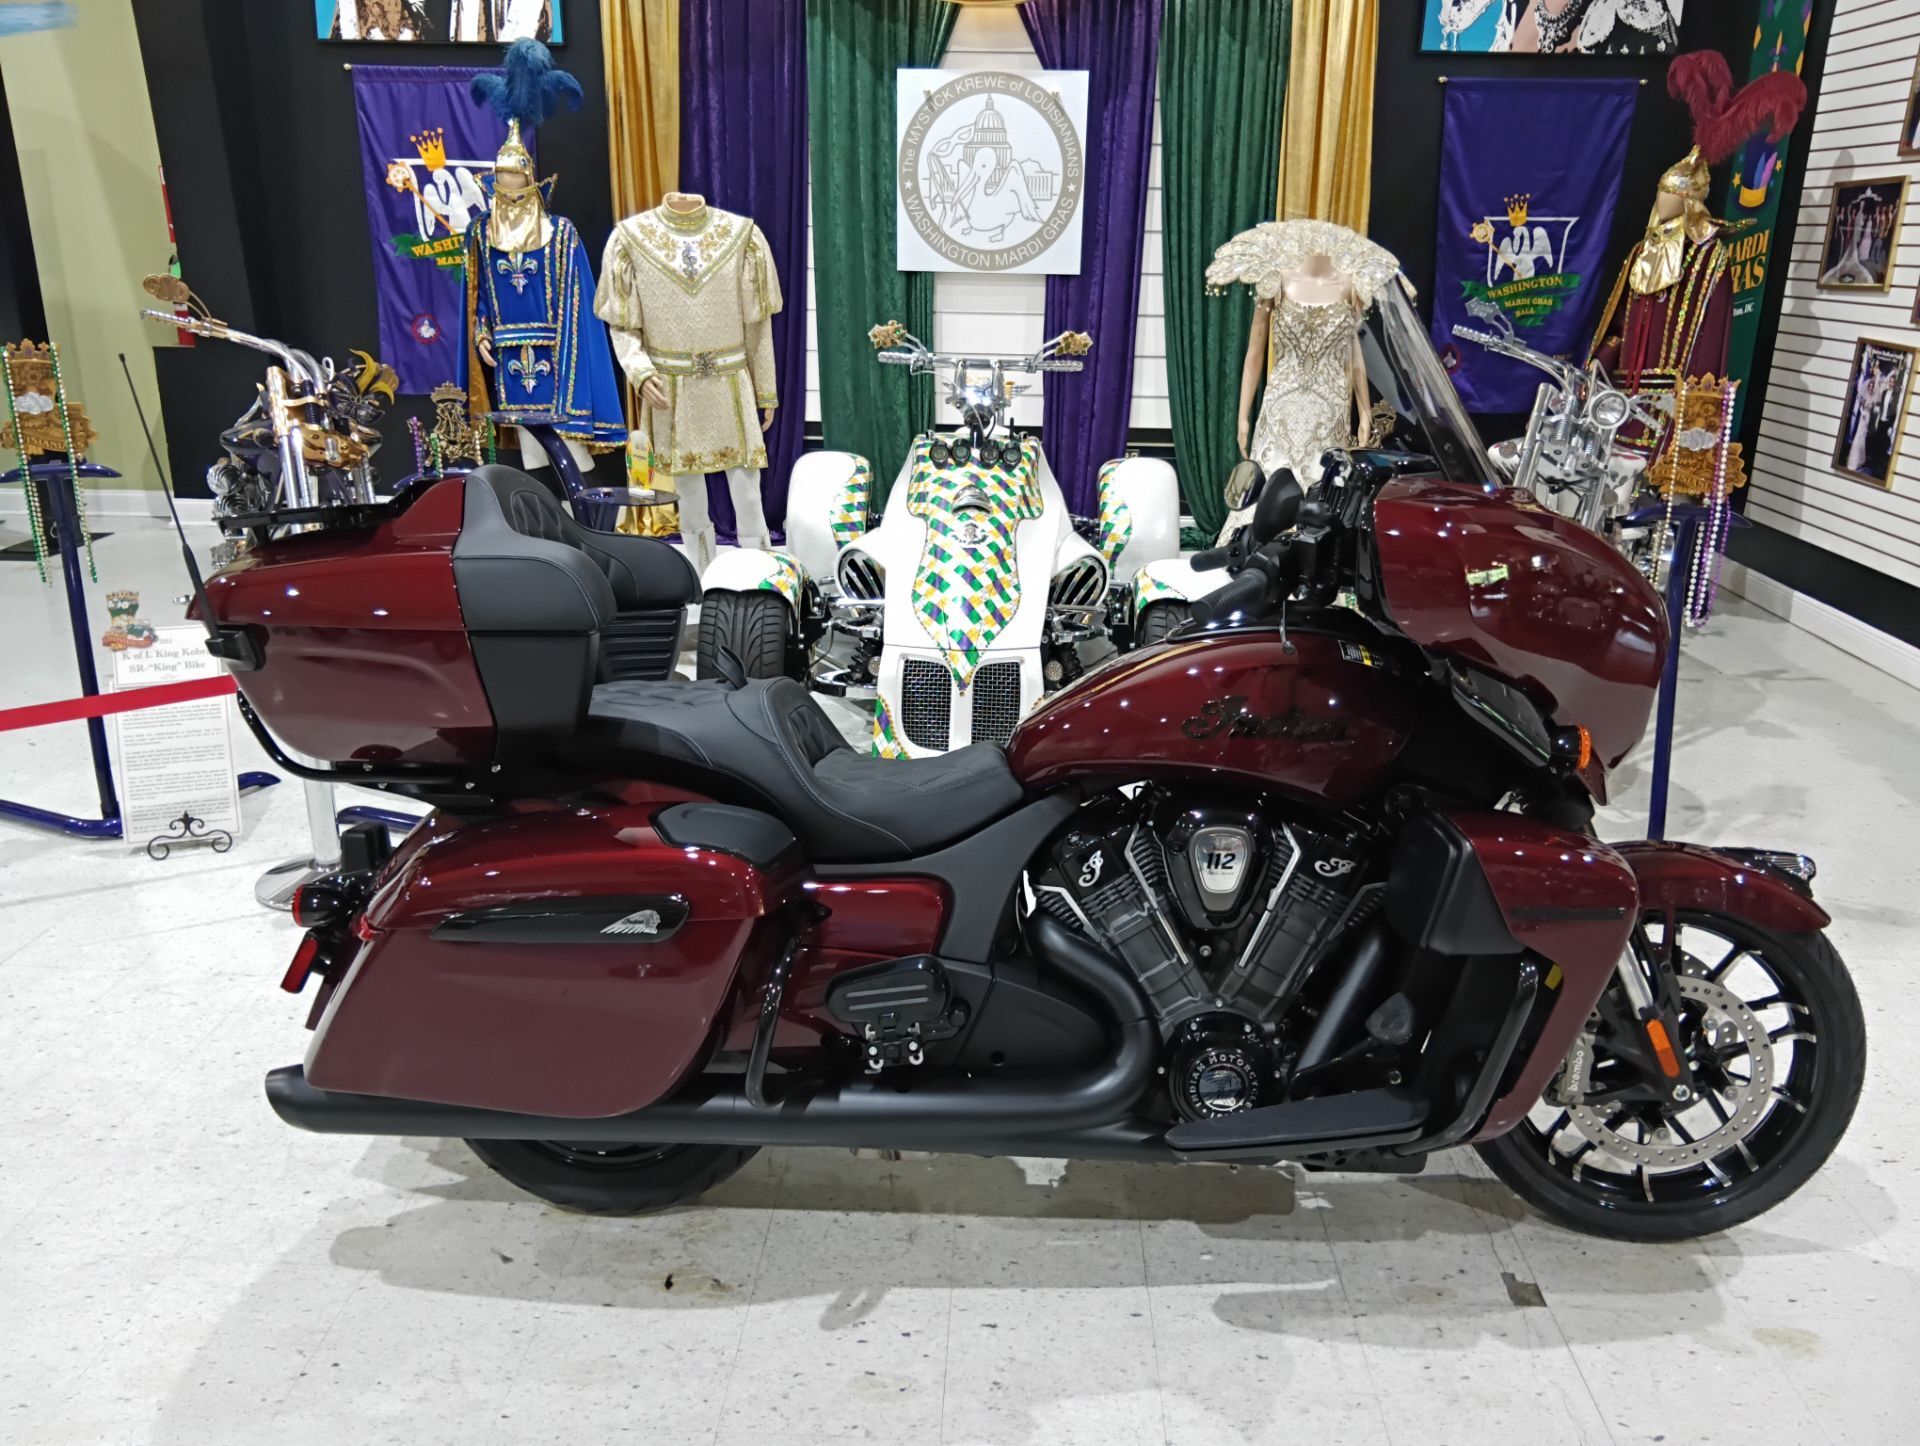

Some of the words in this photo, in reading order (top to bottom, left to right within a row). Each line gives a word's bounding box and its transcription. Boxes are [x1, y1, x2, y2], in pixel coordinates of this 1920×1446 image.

[954, 75, 1006, 94] KREWE
[1009, 81, 1024, 92] of
[908, 89, 954, 145] MYSTICK
[1024, 85, 1079, 178] LOUISIANIANS
[902, 149, 916, 173] The
[906, 193, 991, 267] WASHINGTON
[994, 237, 1044, 266] MARDI
[1043, 198, 1074, 240] GRAS
[411, 234, 465, 257] WASHI
[435, 255, 464, 266] MAR
[1731, 255, 1767, 294] RAS
[1487, 276, 1563, 299] WASHINGTON
[1504, 298, 1531, 308] MARDI
[156, 649, 179, 660] King
[184, 661, 206, 670] Bike
[1207, 852, 1236, 870] 112
[1189, 1062, 1206, 1108] INDIAN
